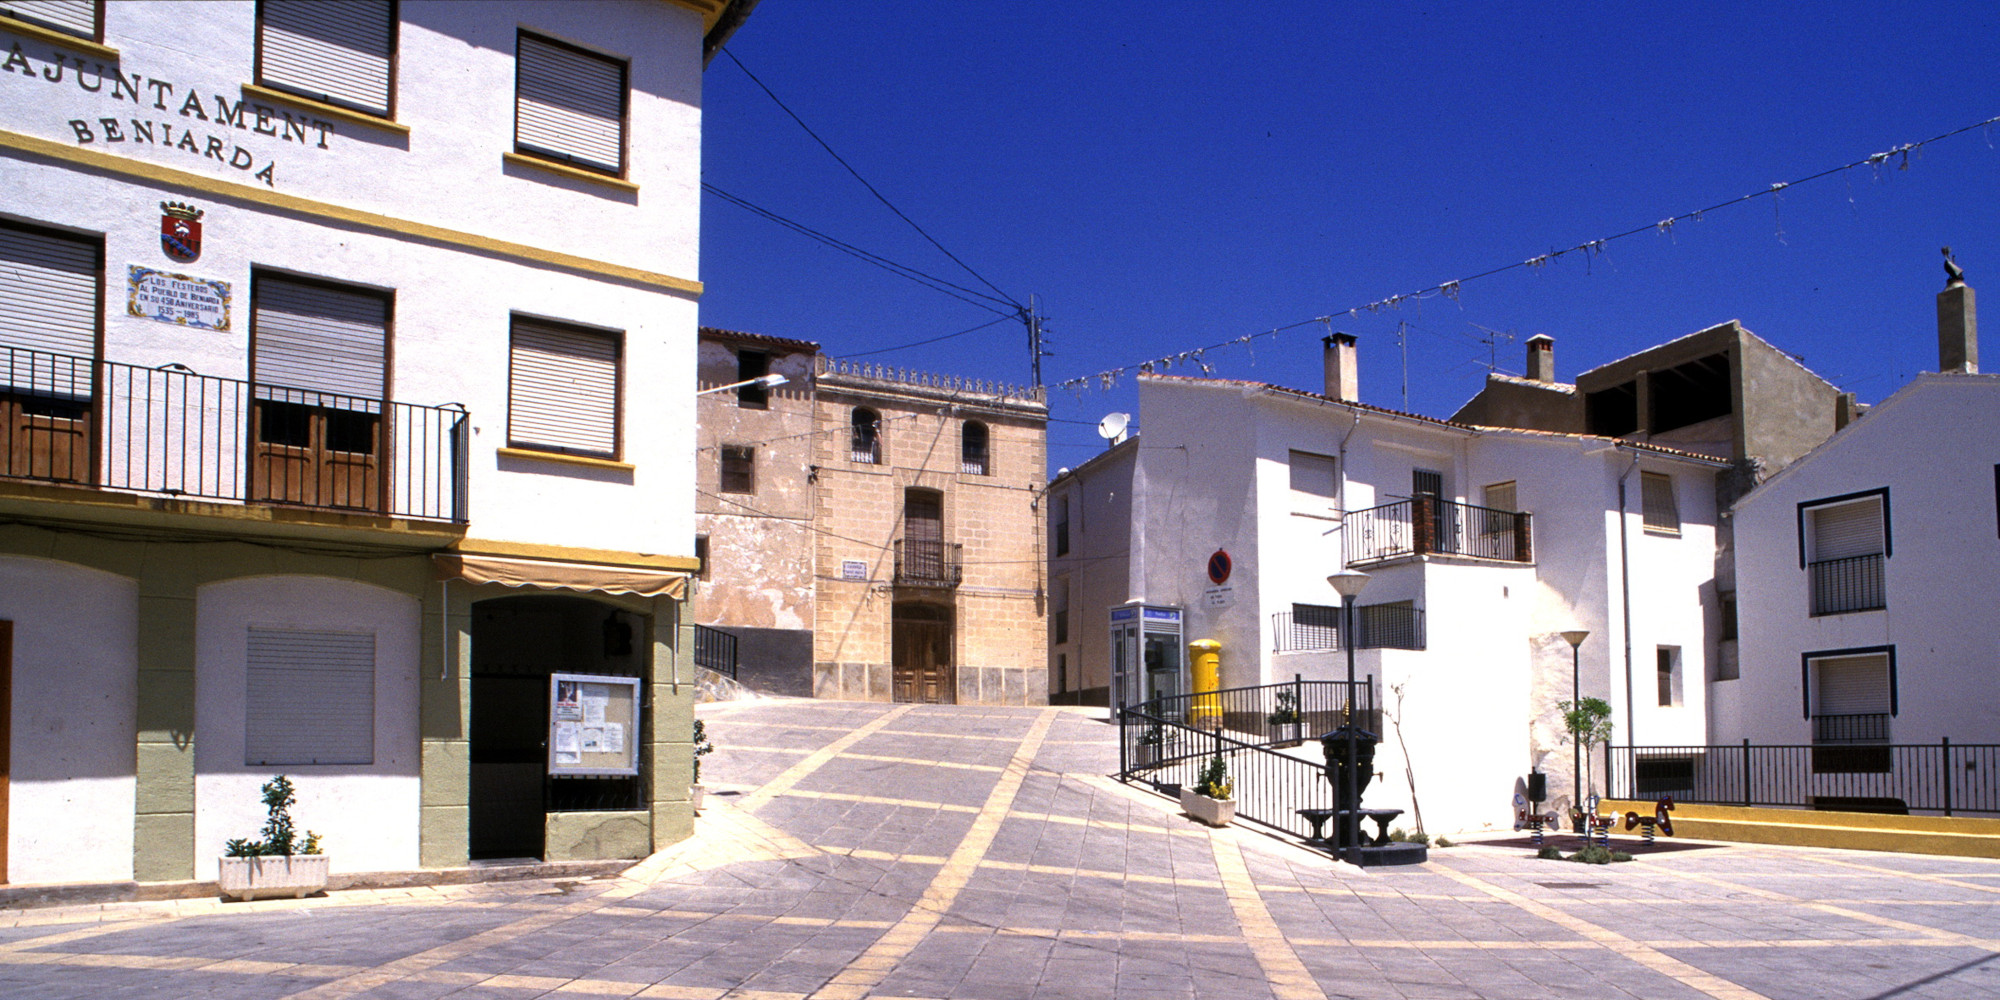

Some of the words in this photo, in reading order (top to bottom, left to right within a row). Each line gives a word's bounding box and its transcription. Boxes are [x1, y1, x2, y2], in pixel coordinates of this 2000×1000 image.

[2, 42, 334, 149] AJUNTAMENT
[139, 284, 149, 292] AL
[152, 286, 178, 297] PUEBLO
[180, 291, 188, 299] DE
[150, 277, 166, 286] LOS
[172, 281, 209, 294] FESTEROS
[158, 306, 174, 316] 1535
[175, 299, 219, 313] ANIVERSARIO
